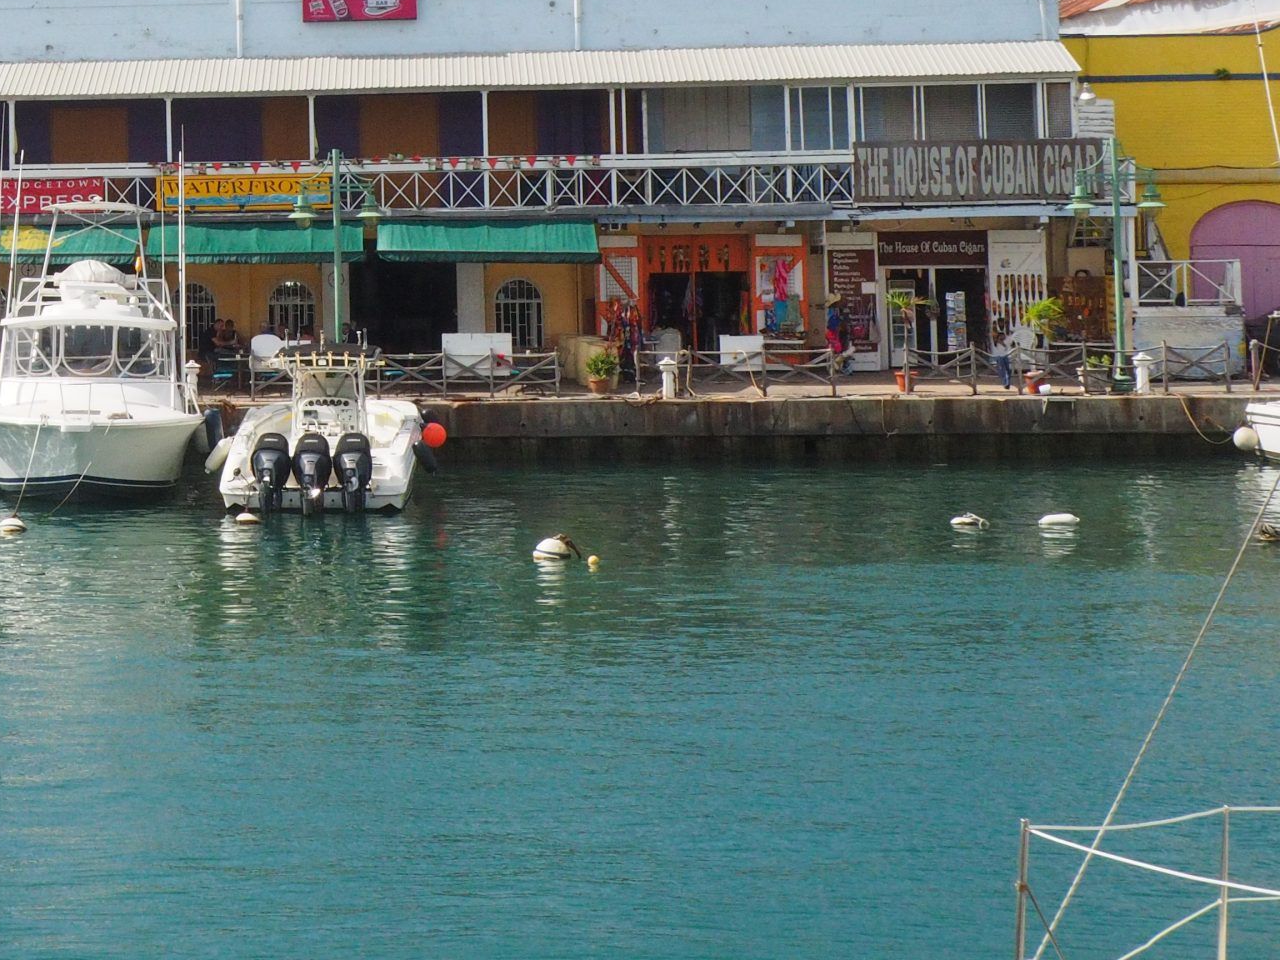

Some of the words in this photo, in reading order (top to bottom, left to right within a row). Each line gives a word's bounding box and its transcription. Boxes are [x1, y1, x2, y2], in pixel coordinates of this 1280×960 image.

[858, 147, 889, 196] THE
[893, 146, 953, 196] HOUSE
[955, 146, 977, 196] OF
[980, 145, 1039, 195] CUBAN
[1043, 145, 1098, 194] CIGAR
[878, 242, 893, 253] The
[895, 241, 919, 253] House
[921, 241, 930, 253] Of
[932, 241, 958, 253] Cuban
[960, 241, 985, 255] Cigars
